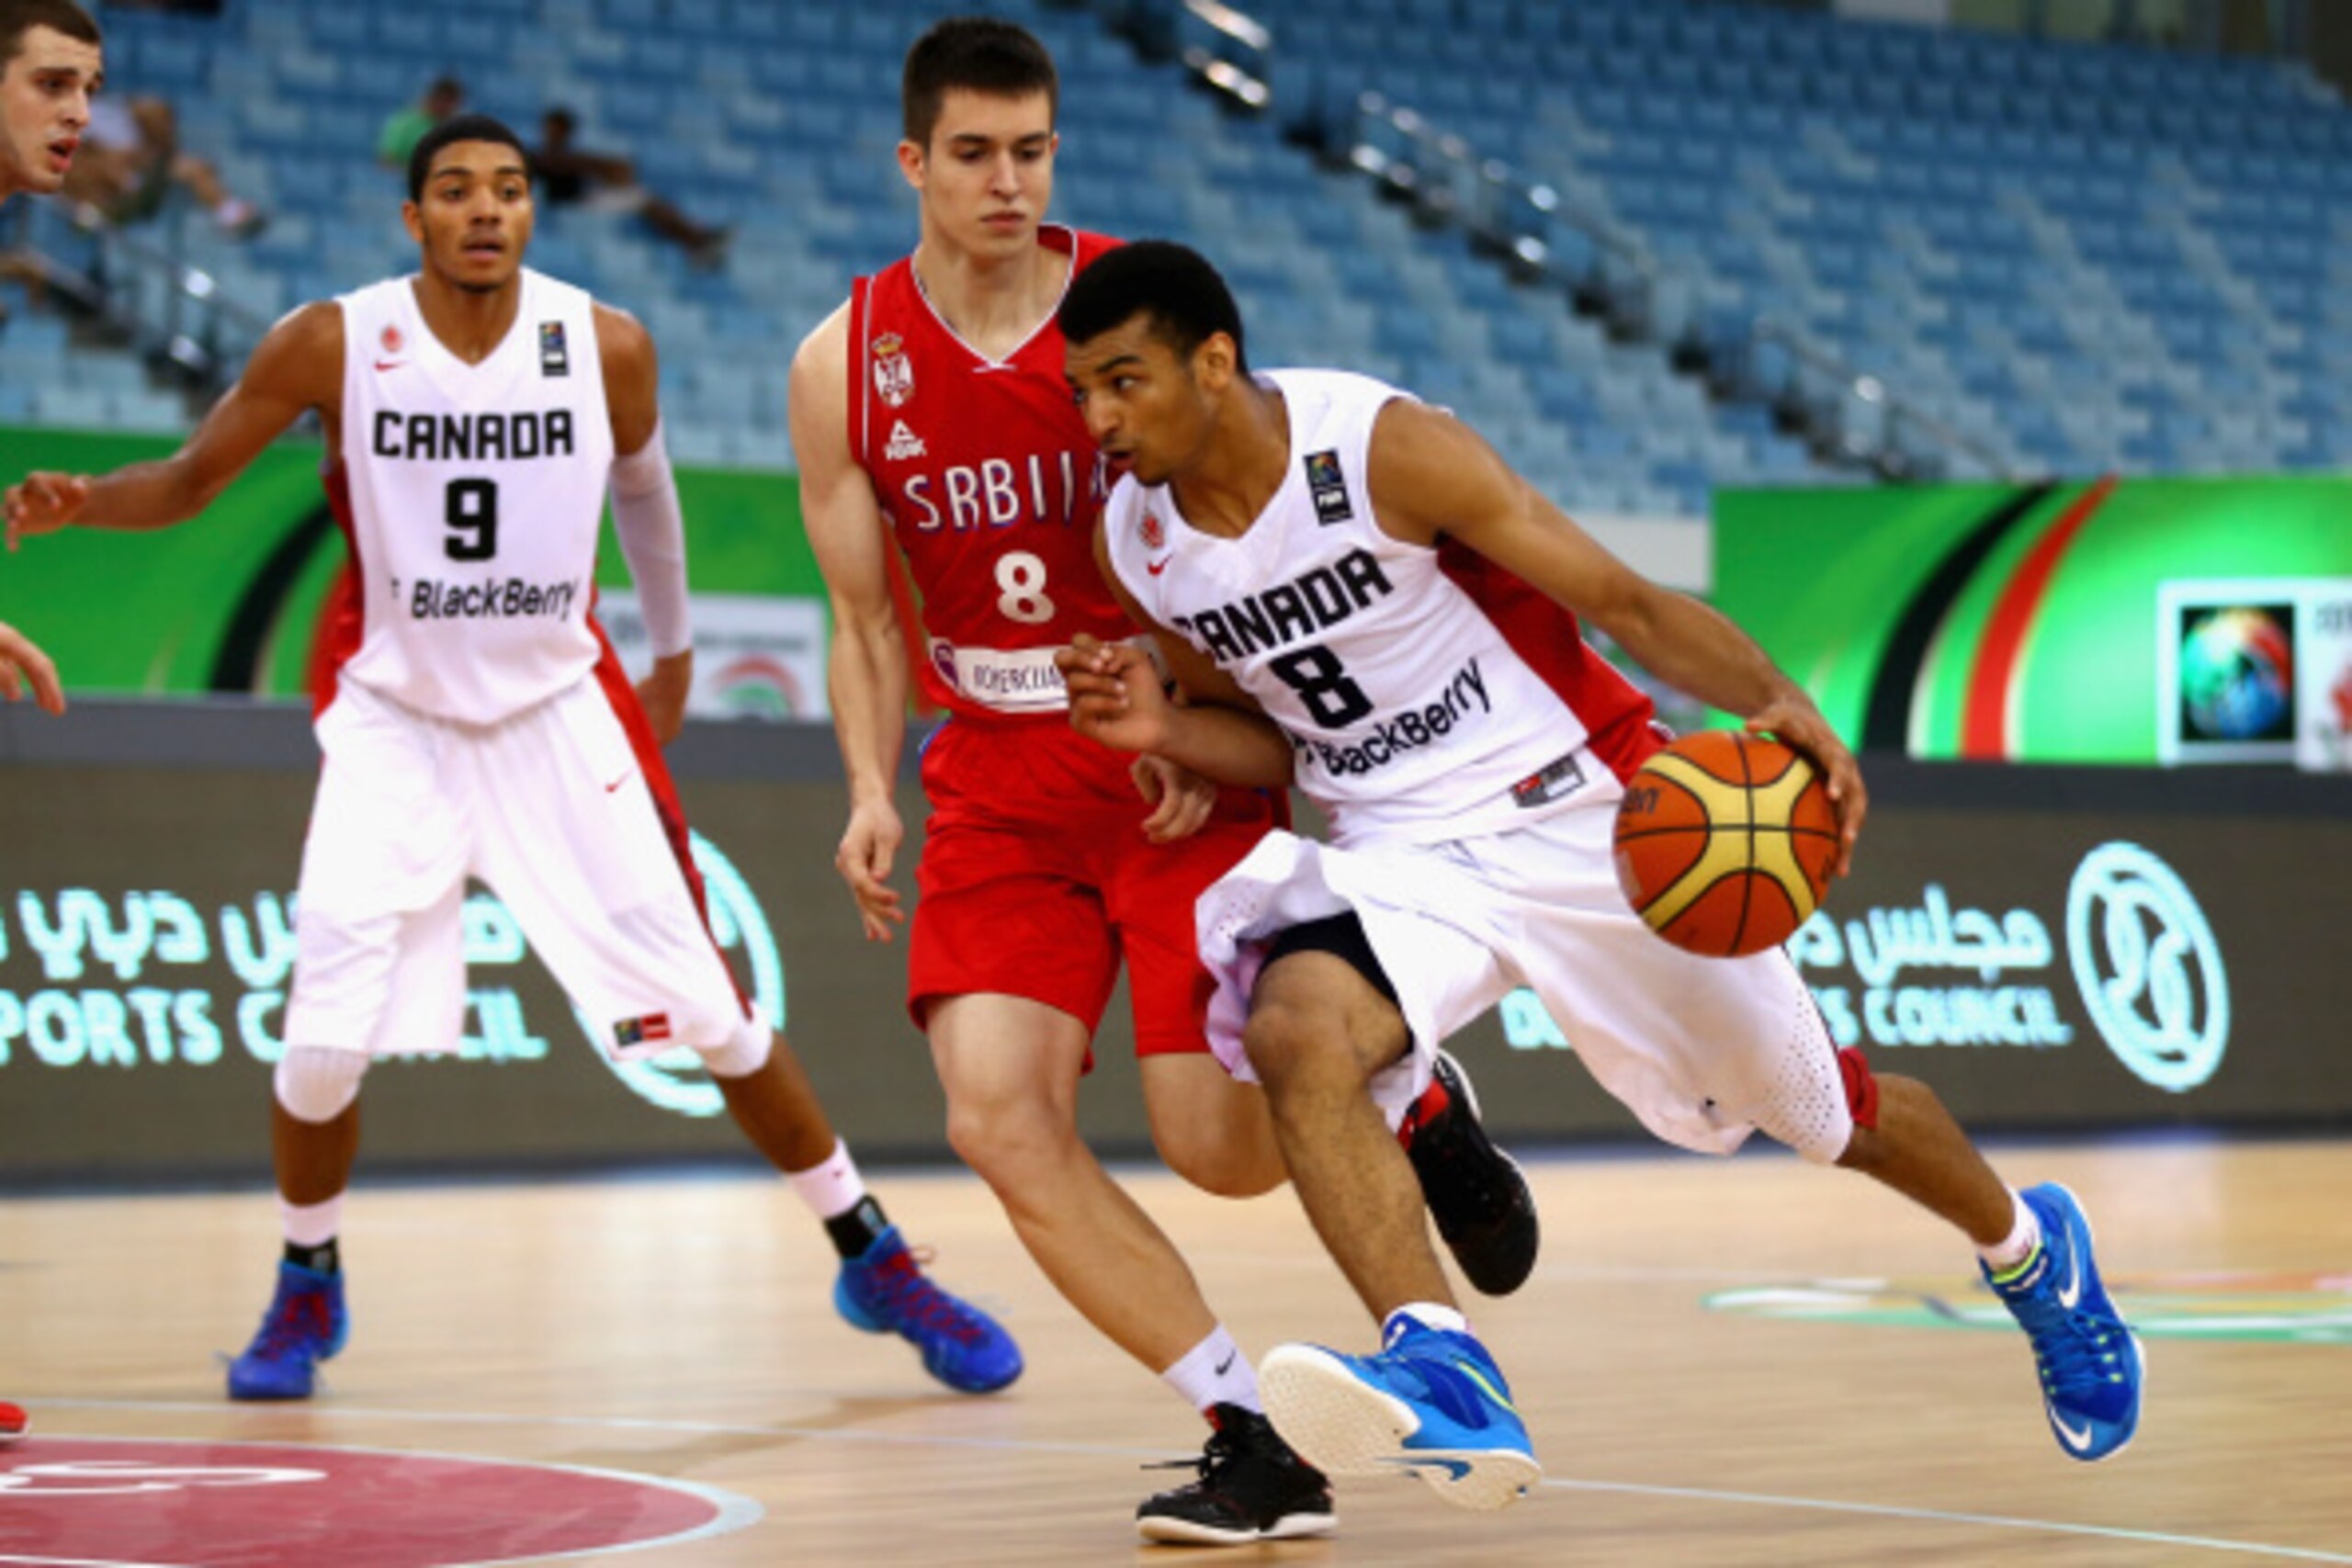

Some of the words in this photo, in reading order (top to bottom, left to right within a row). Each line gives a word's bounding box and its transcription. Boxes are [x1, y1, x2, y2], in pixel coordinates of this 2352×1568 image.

[374, 408, 573, 460] CANADA
[445, 478, 498, 563] 9
[412, 576, 579, 622] BlackBerry
[994, 549, 1056, 625] 8
[1171, 547, 1395, 662] ANADA
[1268, 644, 1374, 729] 8
[1312, 656, 1491, 777] BackBerry
[1845, 883, 2053, 988] مجلس
